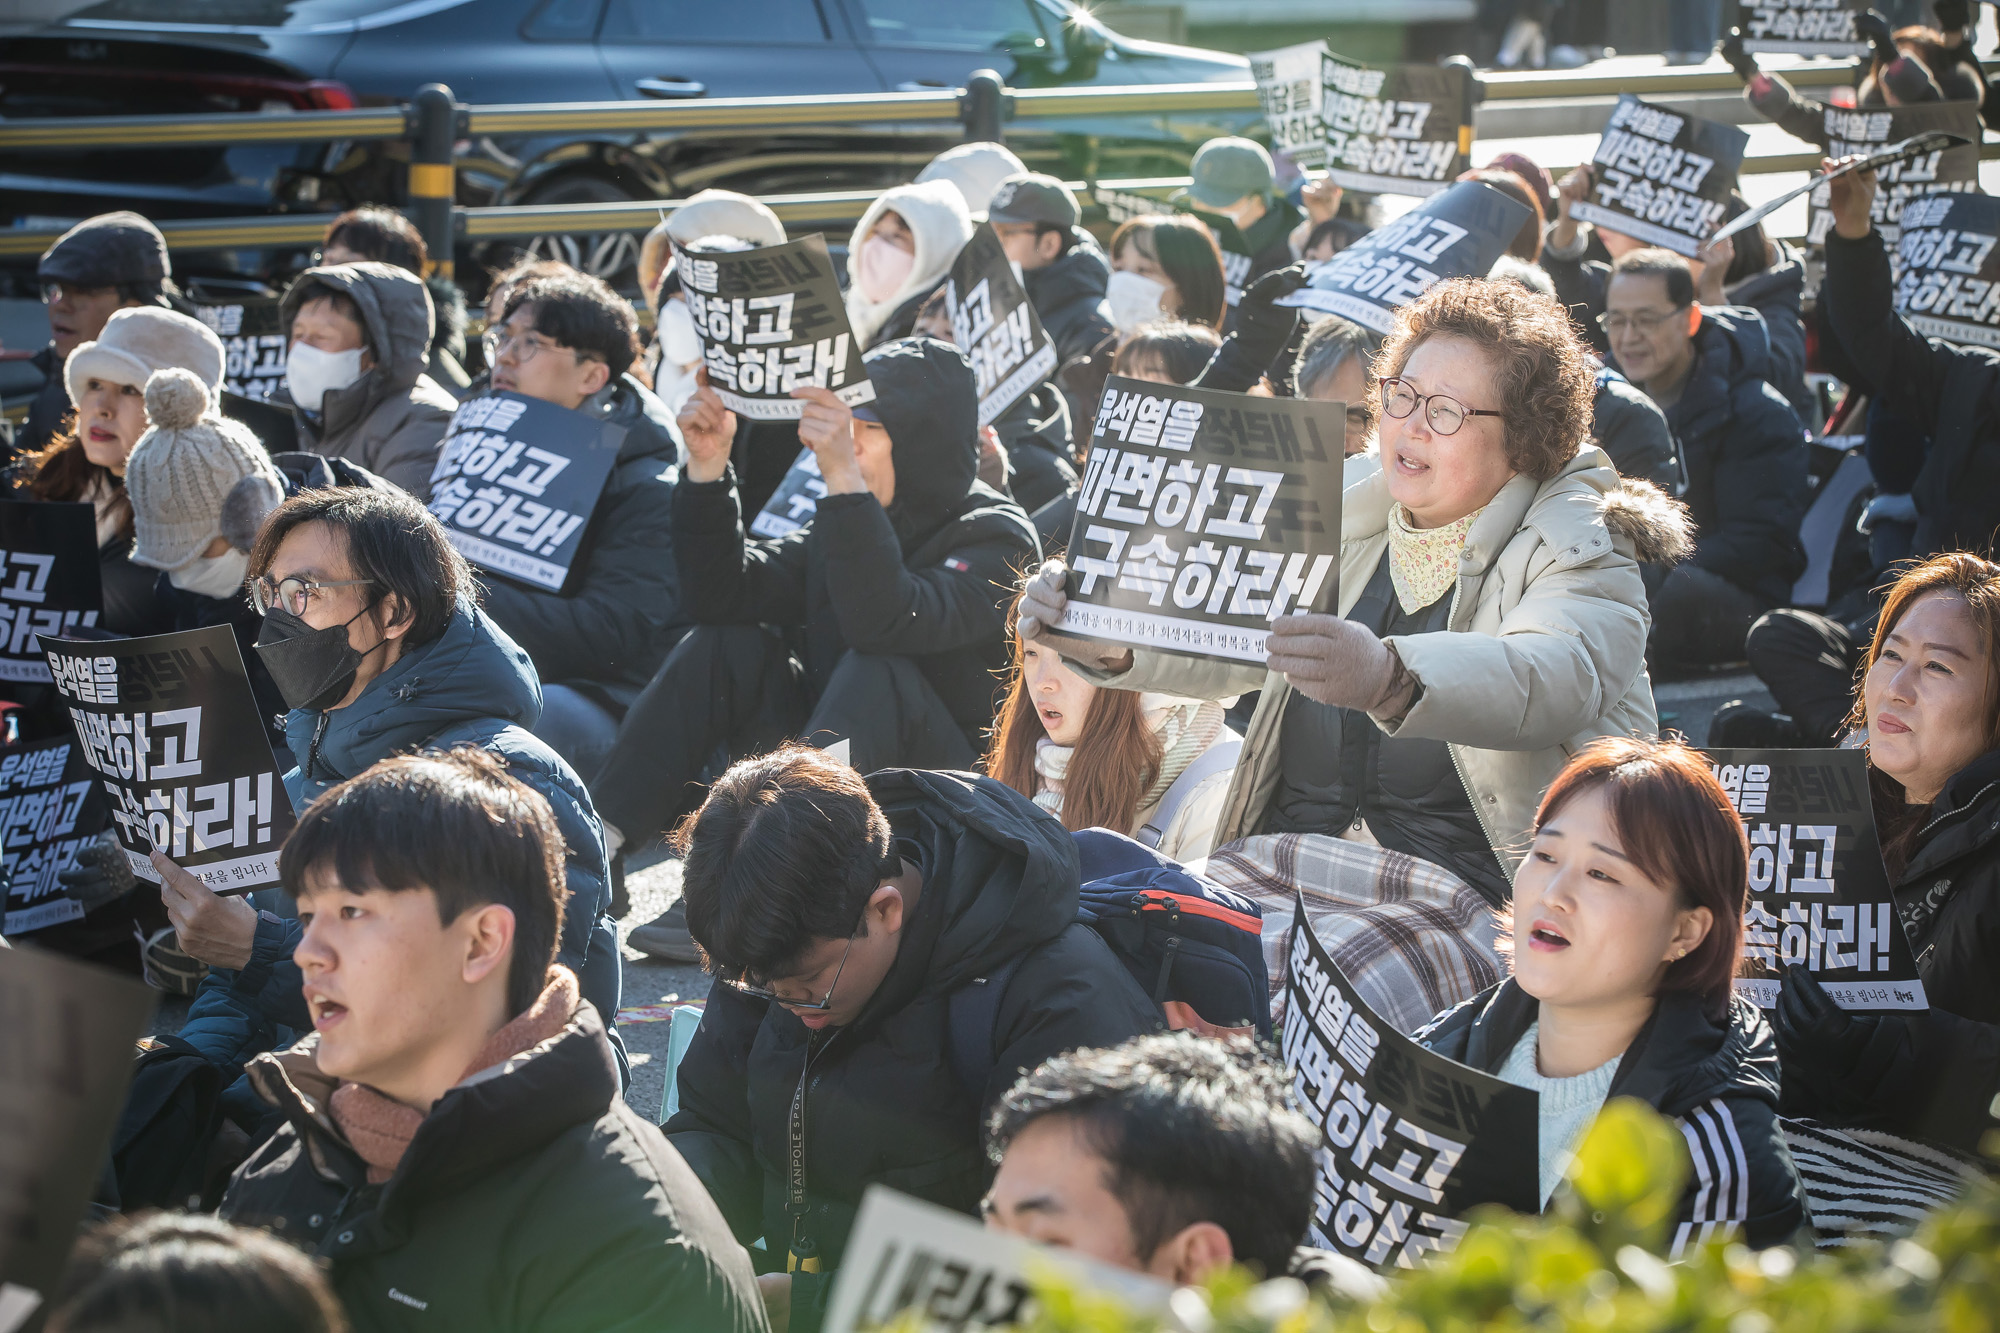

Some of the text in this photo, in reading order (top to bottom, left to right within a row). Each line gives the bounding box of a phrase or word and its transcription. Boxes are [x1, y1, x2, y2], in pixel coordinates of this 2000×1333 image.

[1322, 88, 1432, 139] 파면하고
[1325, 128, 1457, 181] 구속하라!
[1593, 129, 1714, 194] 파면하고
[1595, 168, 1726, 239] 구속하라!
[221, 335, 287, 378] 하고
[1094, 388, 1204, 452] 윤석열을
[1076, 446, 1285, 541] 파면하고
[1072, 524, 1334, 622] 구속하라!
[1102, 616, 1133, 635] 여객기
[1136, 620, 1156, 638] 참사
[1160, 625, 1213, 646] 희생자들의
[1217, 633, 1250, 651] 명복을
[1255, 639, 1266, 654] 빕
[48, 651, 118, 704] 윤석열을
[0, 744, 71, 792] 윤석열을
[69, 706, 202, 782] 파면하고
[103, 771, 273, 858] 구속하라!
[1712, 764, 1770, 814] 열을
[231, 862, 268, 880] 빕니다
[1742, 823, 1837, 893] 하고
[1742, 900, 1891, 972] 속하라!
[1290, 924, 1380, 1078] 윤석열을
[1857, 988, 1889, 1003] 빕니다
[1282, 988, 1467, 1205] 파면하고
[792, 1132, 803, 1204] BEANPOLE
